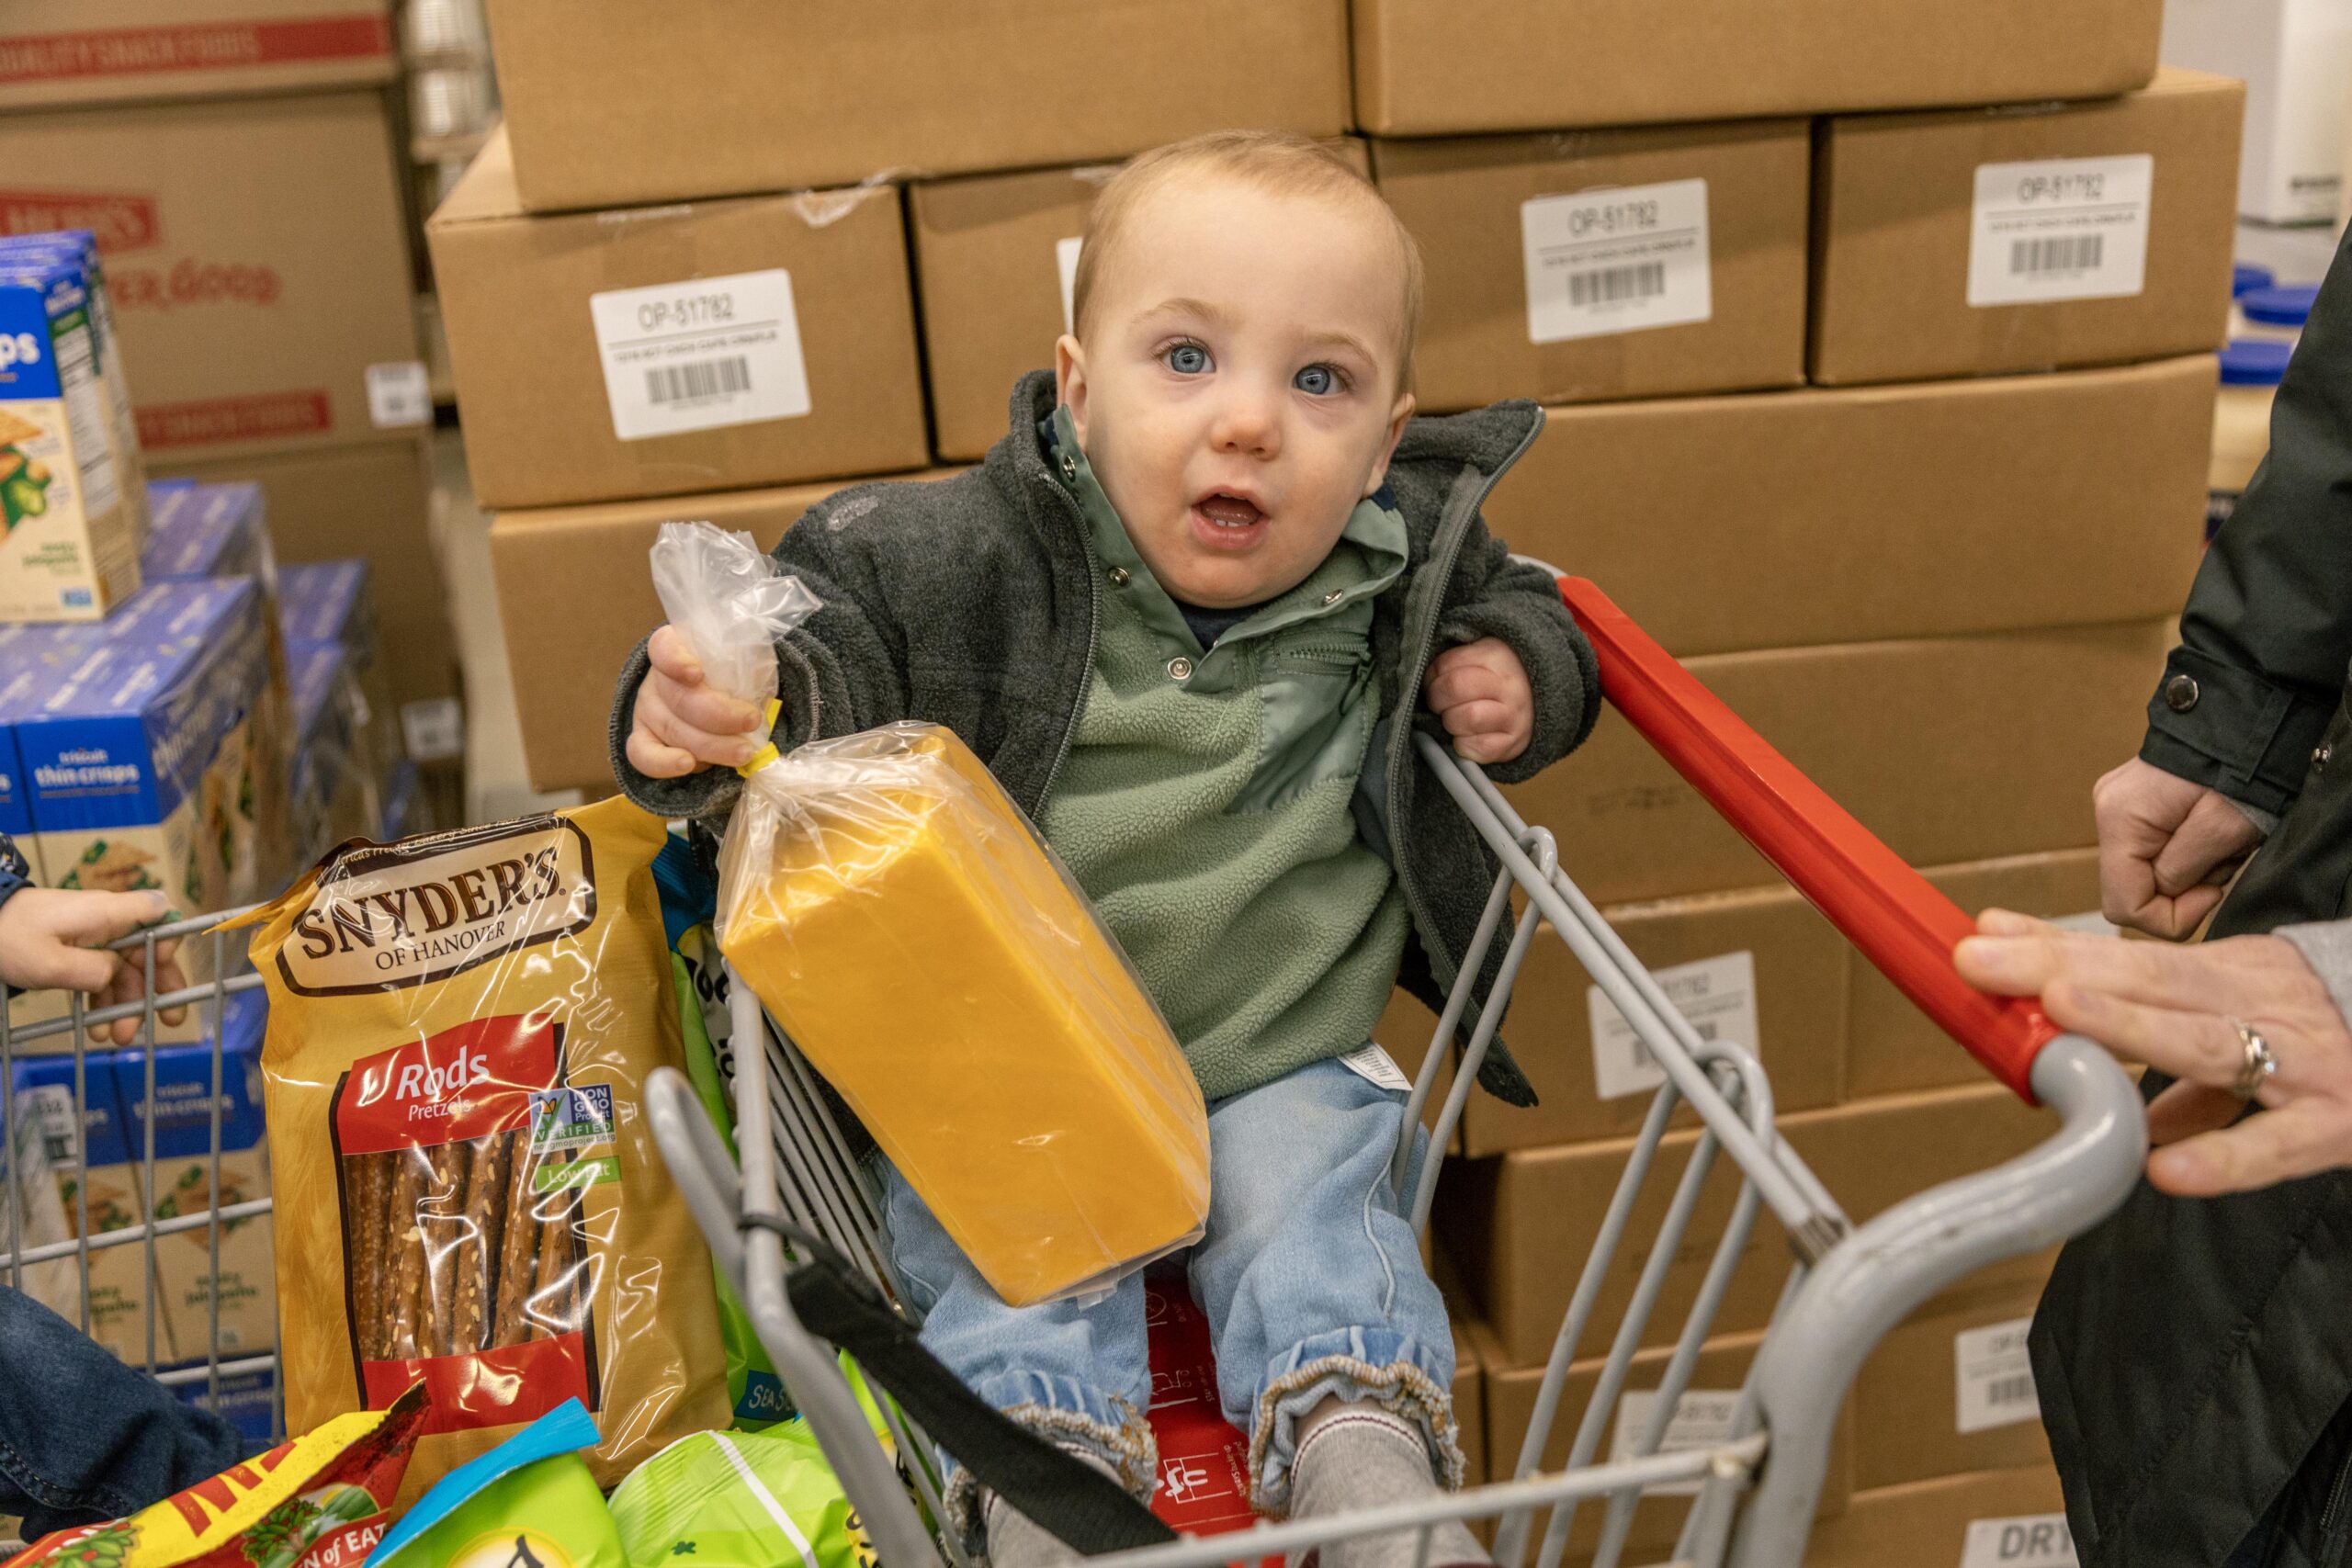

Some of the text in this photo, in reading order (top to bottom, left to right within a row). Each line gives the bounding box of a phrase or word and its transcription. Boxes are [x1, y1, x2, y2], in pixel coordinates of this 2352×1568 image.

[297, 847, 560, 959] SNYDER'S
[375, 920, 506, 971] OF HANOVER
[395, 1045, 490, 1100] Rods
[409, 1094, 471, 1122] Pretzels
[573, 1088, 607, 1101] NON
[575, 1110, 610, 1122] Projct
[323, 1537, 341, 1566] of
